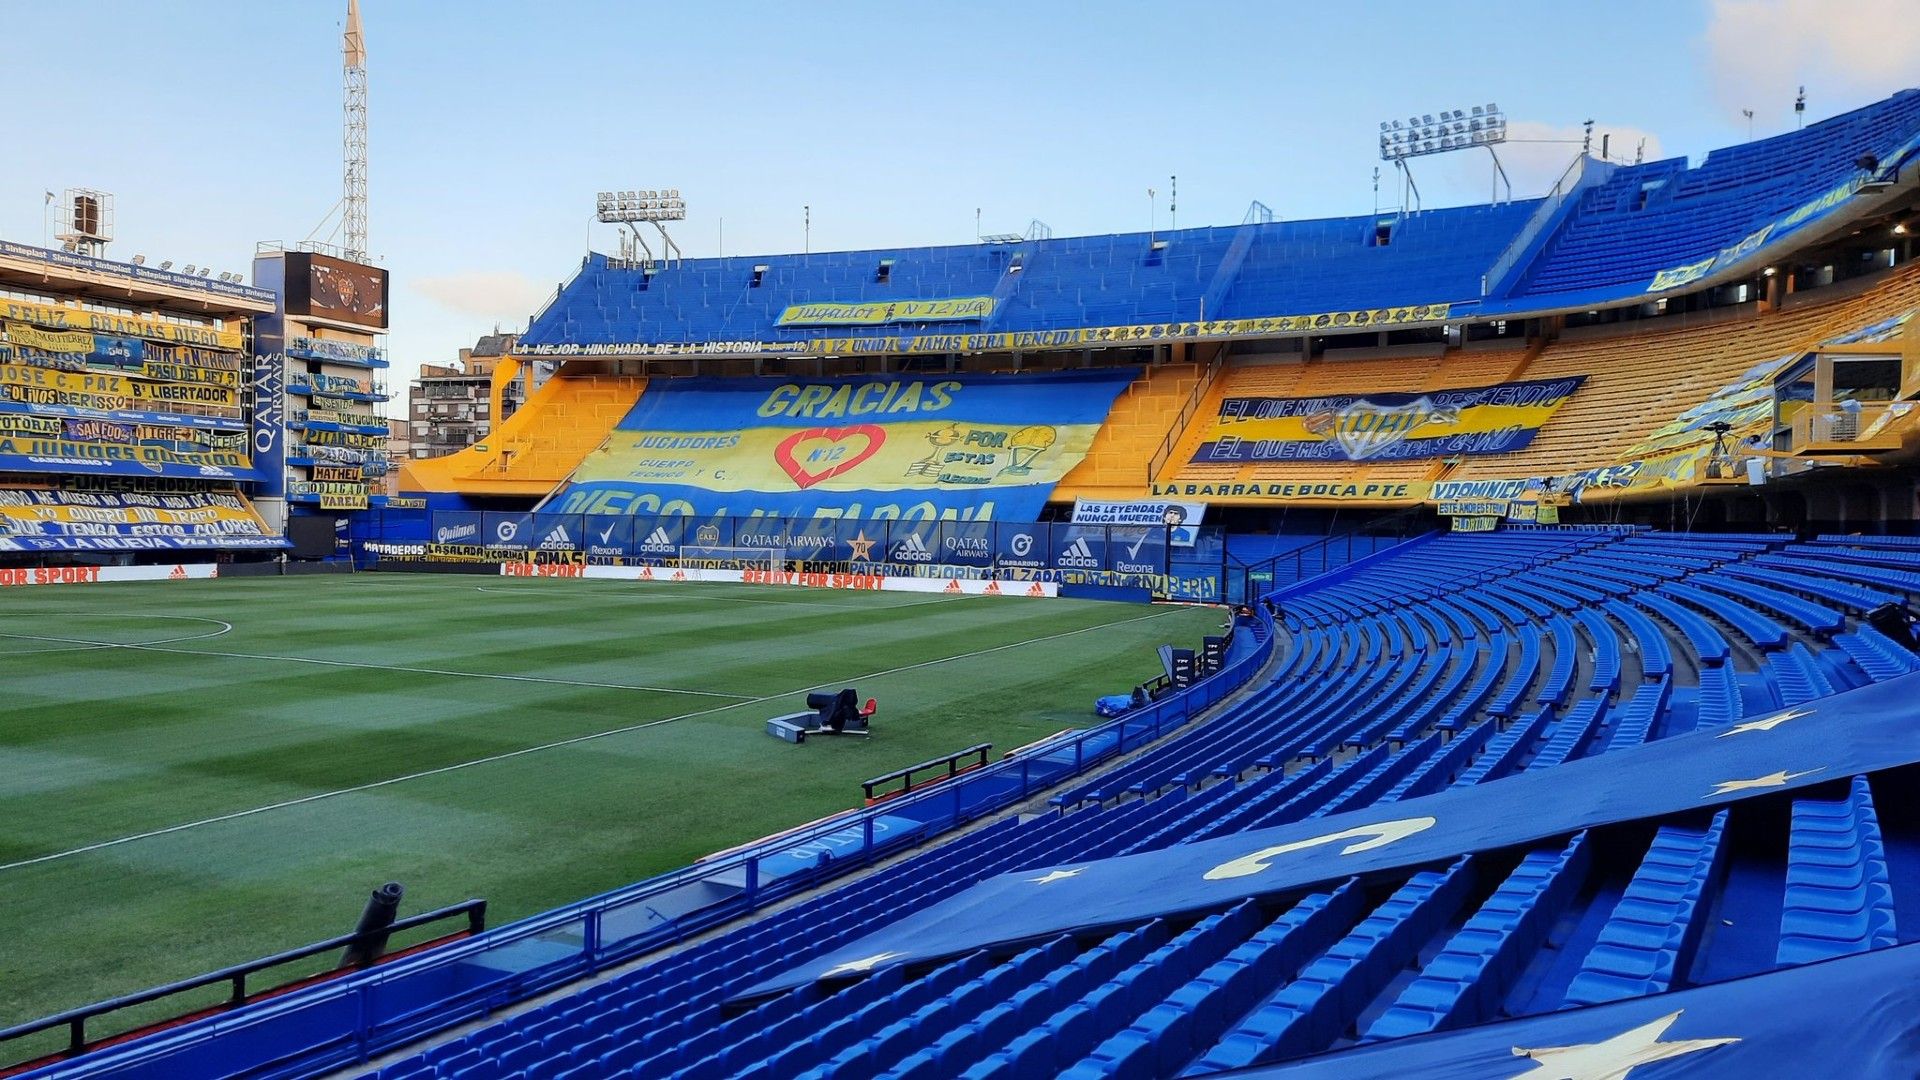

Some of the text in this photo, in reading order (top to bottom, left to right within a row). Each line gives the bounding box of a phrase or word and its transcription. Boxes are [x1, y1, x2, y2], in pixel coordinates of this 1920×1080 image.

[89, 314, 165, 339] GRACIAS
[174, 326, 219, 347] DIEGO
[512, 343, 529, 355] LA
[534, 343, 579, 355] MEJOR
[584, 343, 649, 355] HINCHADA
[654, 343, 673, 355] DE
[678, 342, 696, 354] LA
[702, 341, 762, 354] HISTORIA
[851, 338, 895, 352] UNIDA
[913, 336, 962, 351] JAMAS
[1013, 330, 1081, 347] VENCIDA
[147, 364, 224, 384] PASO DEL REY
[84, 376, 119, 392] PAZ
[272, 352, 283, 426] AIRWAYS
[59, 391, 126, 410] BERISSO
[151, 385, 229, 402] LIBERTADOR
[757, 380, 963, 418] GRACIAS
[255, 352, 276, 453] QATAR
[338, 413, 388, 427] TORTUGUITAS
[1219, 400, 1249, 426] EL
[1254, 399, 1292, 420] QUE
[77, 420, 100, 437] SAN
[143, 427, 181, 440] TIGRE
[194, 429, 247, 448] MERCEDES
[632, 434, 741, 450] JUGADORES
[963, 430, 1008, 448] POR
[27, 440, 135, 460] JUNIORS
[1208, 435, 1242, 459] EL
[1251, 439, 1296, 460] QUE
[1296, 441, 1336, 459] MAS
[639, 459, 696, 468] CUERPO
[944, 452, 996, 465] ESTAS
[315, 467, 359, 480] MATHEU
[310, 482, 369, 495] OBLIGADO
[1152, 484, 1179, 496] LA
[1185, 484, 1262, 496] BARRA
[1267, 484, 1294, 496] DE
[1300, 483, 1358, 496] BOCA
[58, 491, 101, 506] MUERA
[121, 492, 160, 507] QUIERO
[161, 495, 191, 509] NADA
[321, 495, 367, 507] VARELA
[32, 508, 57, 519] YO
[69, 508, 128, 522] QUIERO
[164, 509, 218, 524] TRAPO
[1080, 504, 1165, 513] LAS LEYENDAS
[1075, 513, 1163, 523] NUNCA MUEREN
[54, 521, 121, 537] TENGA
[130, 524, 186, 537] ESTOS
[193, 519, 262, 536] COLORES
[438, 523, 476, 544] Quilmes
[57, 538, 95, 549] LA
[92, 538, 173, 549] NUEVA
[540, 541, 576, 550] adidas
[640, 543, 676, 553] adidas
[741, 534, 835, 547] QATAR AIRWAYS
[856, 542, 866, 553] 70
[946, 536, 988, 551] QATAR
[364, 542, 426, 555] MATADEROS
[591, 545, 623, 555] Rexona
[895, 550, 932, 561] adidas
[956, 550, 989, 558] AIRWAYS
[1058, 556, 1098, 567] adidas
[1116, 561, 1154, 573] Rexona
[34, 565, 100, 584] SPORT
[505, 561, 588, 578] FOR SPORT
[743, 568, 886, 591] READY FOR SPORT
